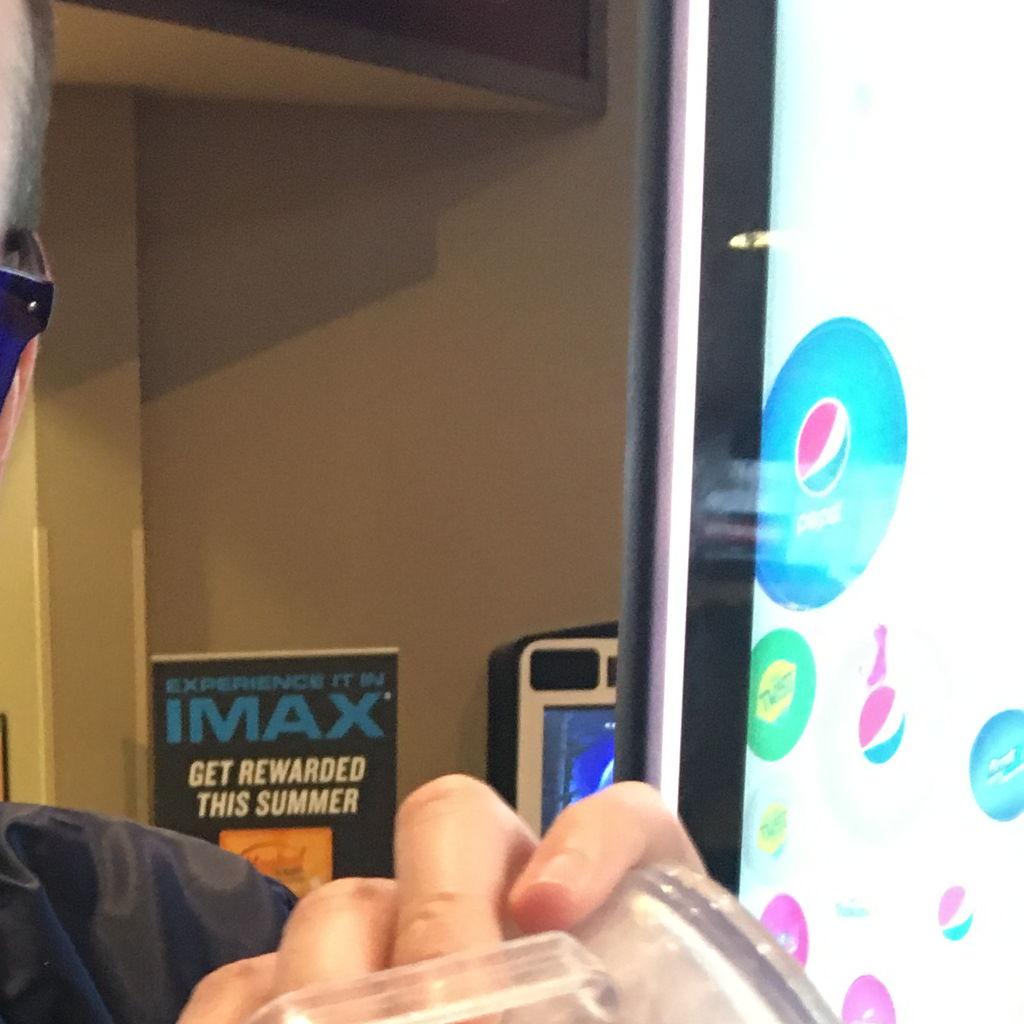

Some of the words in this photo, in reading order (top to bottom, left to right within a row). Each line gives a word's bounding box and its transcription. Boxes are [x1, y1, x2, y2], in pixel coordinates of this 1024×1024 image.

[166, 673, 324, 693] EXPERIENCE
[332, 673, 353, 688] IT
[359, 671, 385, 686] IN
[165, 691, 385, 744] IMAX
[188, 759, 234, 788] GET
[238, 755, 366, 786] REWARDED
[197, 790, 251, 819] THIS
[255, 787, 360, 817] SUMMER
